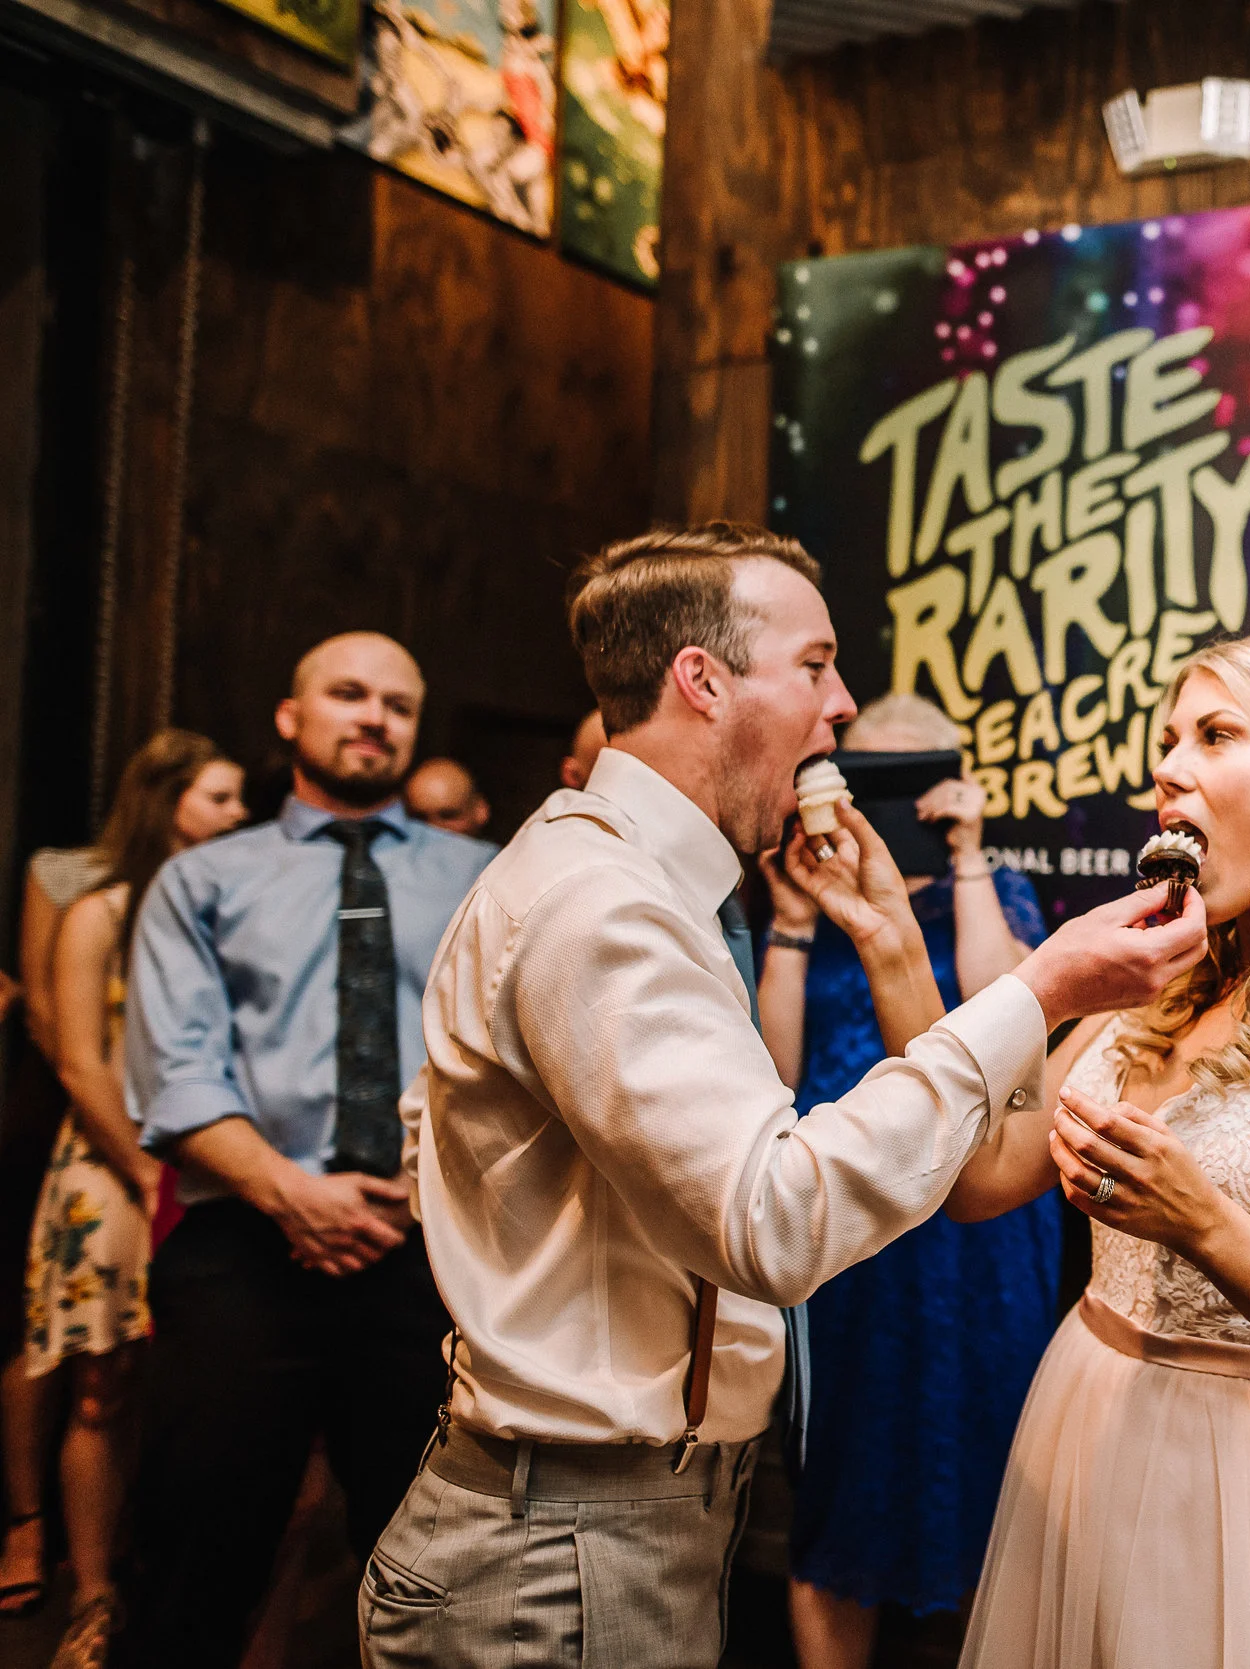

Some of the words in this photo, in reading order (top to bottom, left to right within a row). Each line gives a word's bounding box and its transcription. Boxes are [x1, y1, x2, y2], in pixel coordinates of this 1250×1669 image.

[859, 326, 1222, 578] TASTE
[945, 453, 1140, 616] THE
[974, 703, 1163, 820] BREW
[980, 846, 1054, 875] ONAL
[1060, 847, 1130, 876] BEER
